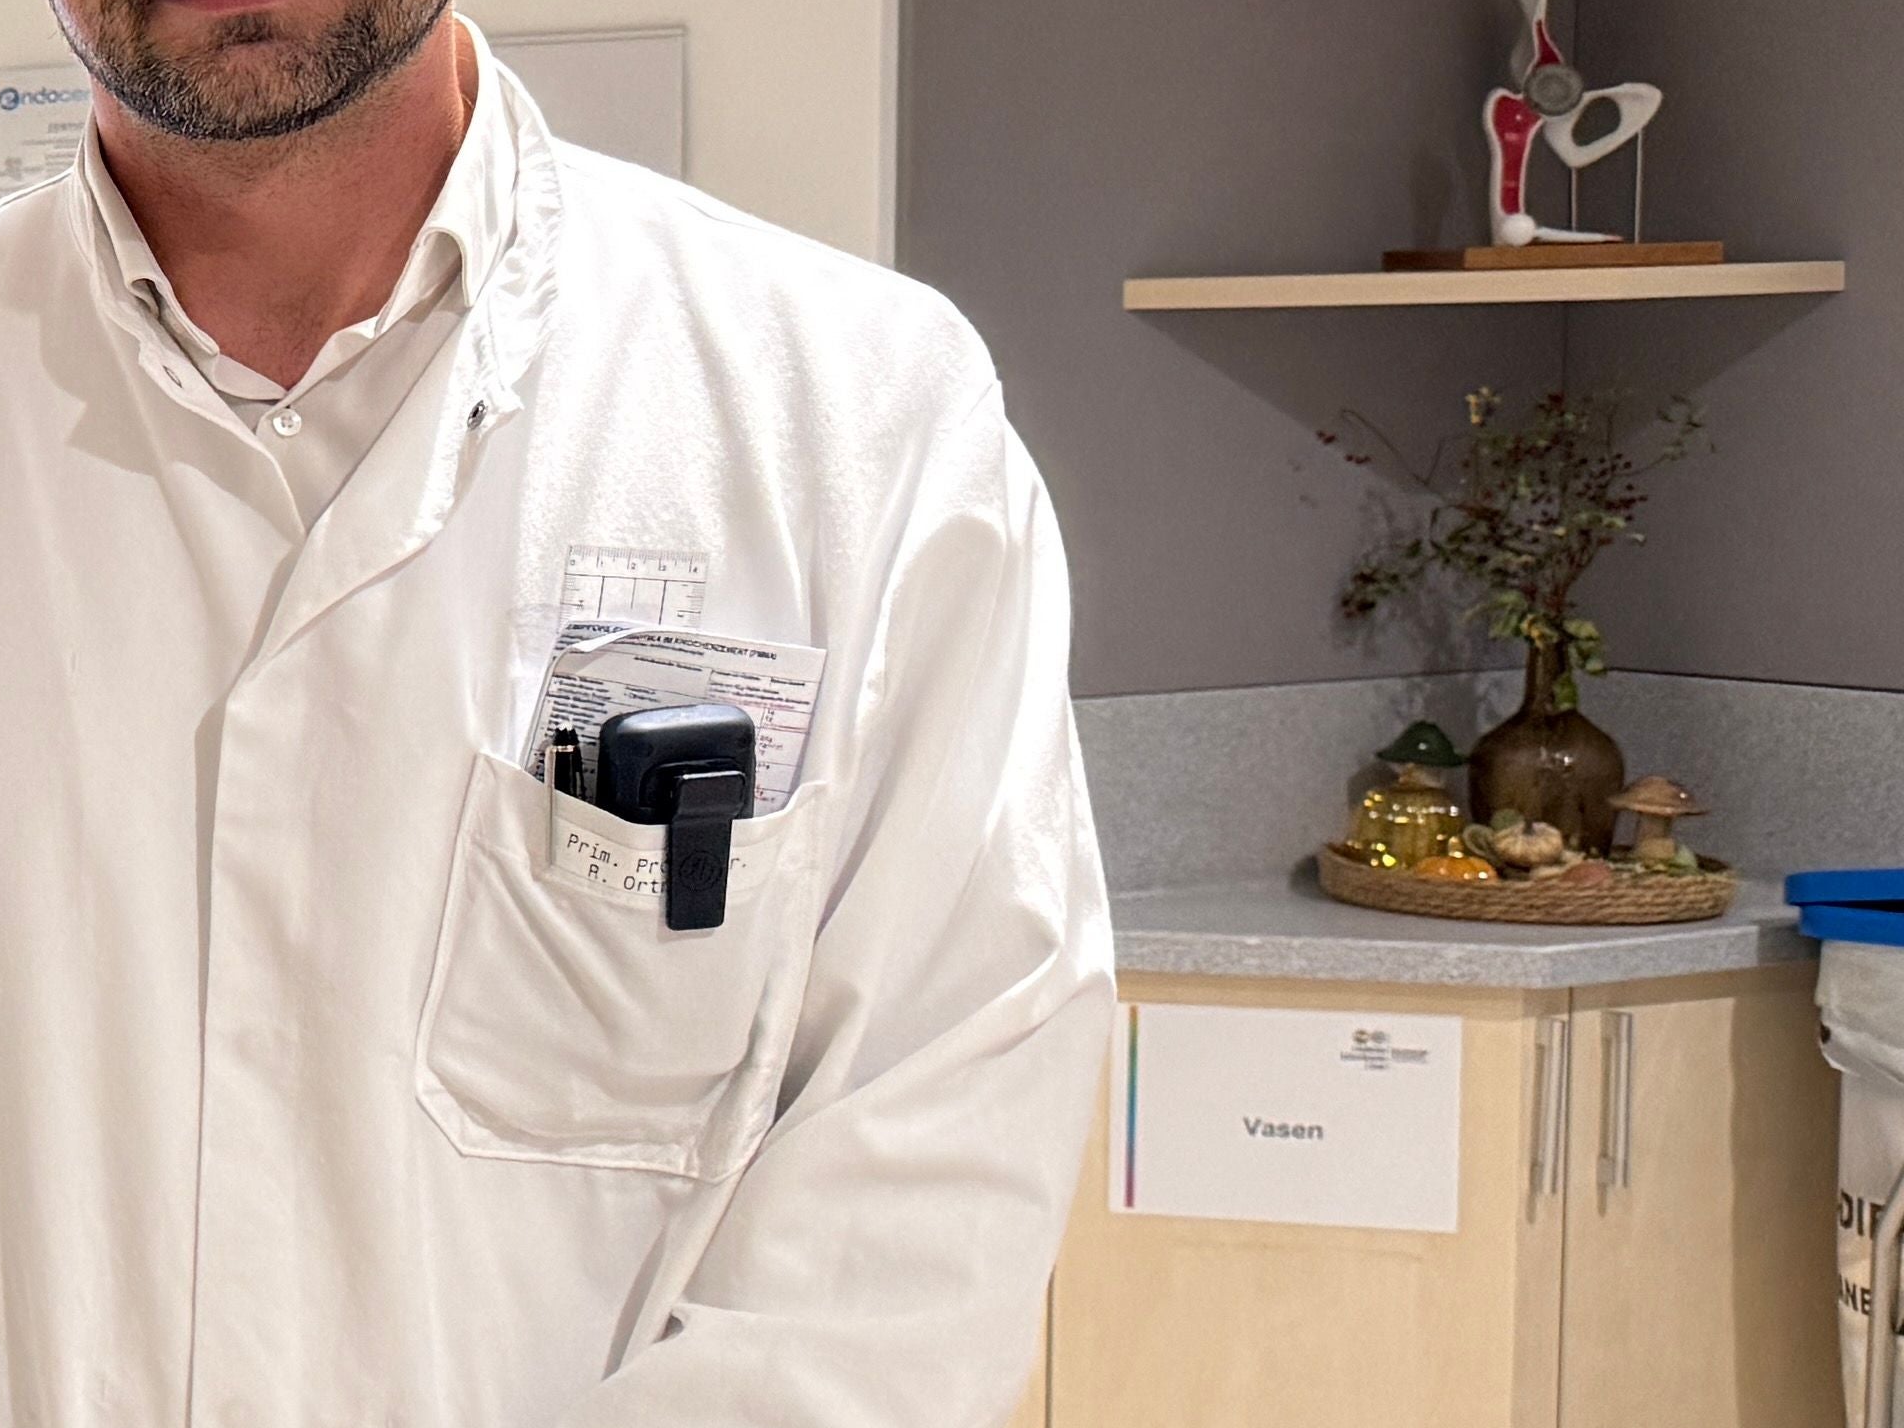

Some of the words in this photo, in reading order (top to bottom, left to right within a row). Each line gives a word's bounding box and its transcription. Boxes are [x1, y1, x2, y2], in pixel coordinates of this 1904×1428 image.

[567, 833, 618, 867] Prim.
[636, 858, 668, 874] Pro
[729, 857, 747, 870] r.
[1243, 1116, 1324, 1140] Vasen
